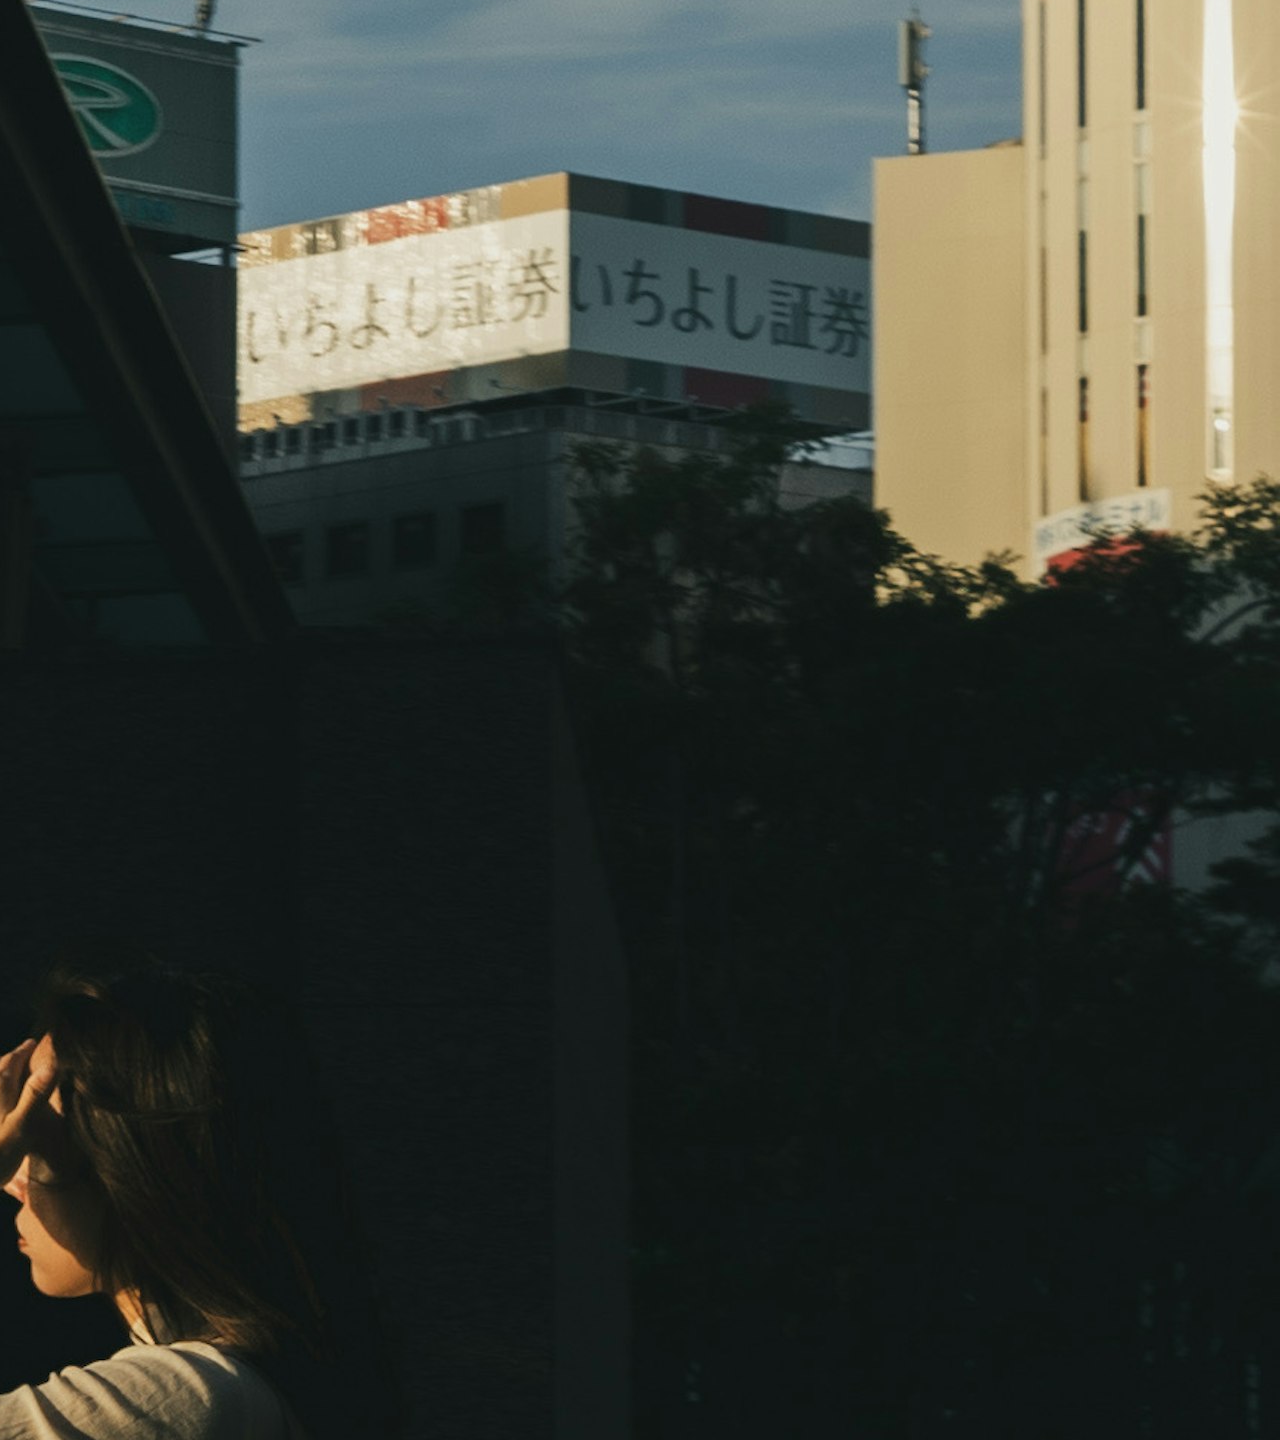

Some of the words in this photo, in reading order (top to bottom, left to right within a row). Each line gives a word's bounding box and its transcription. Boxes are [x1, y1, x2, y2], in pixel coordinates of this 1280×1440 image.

[244, 247, 561, 364] いちよし証券
[570, 255, 870, 359] いちよし証券
